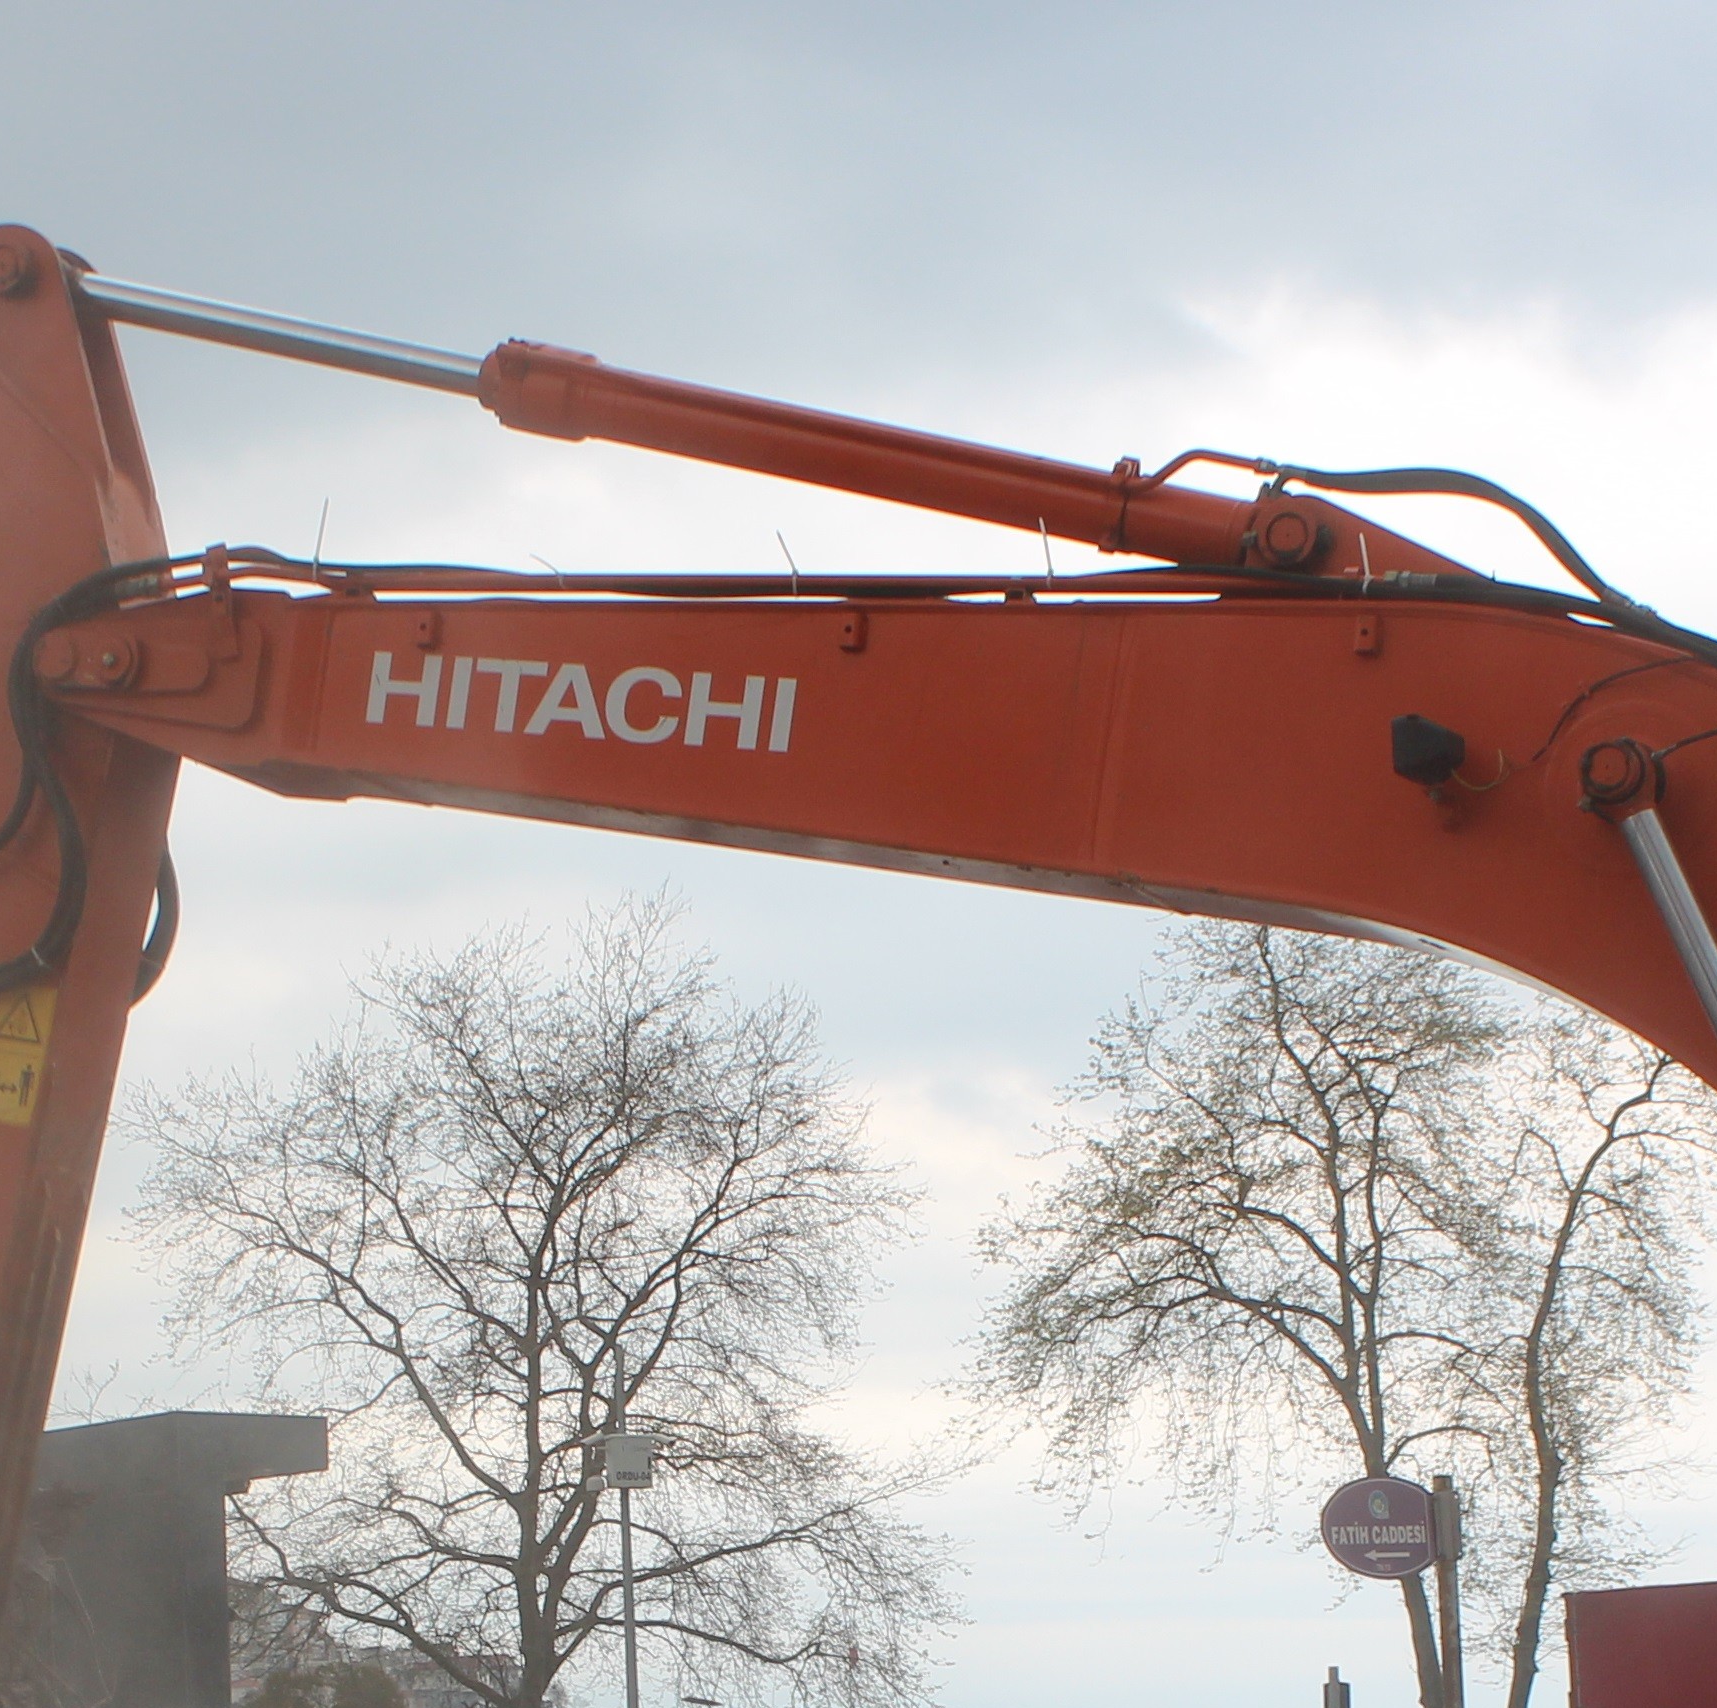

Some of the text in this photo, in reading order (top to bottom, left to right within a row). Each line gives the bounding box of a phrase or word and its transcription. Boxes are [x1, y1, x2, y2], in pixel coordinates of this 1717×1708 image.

[365, 650, 798, 753] HITACHI
[1331, 1520, 1426, 1545] FATİH CADDESİ
